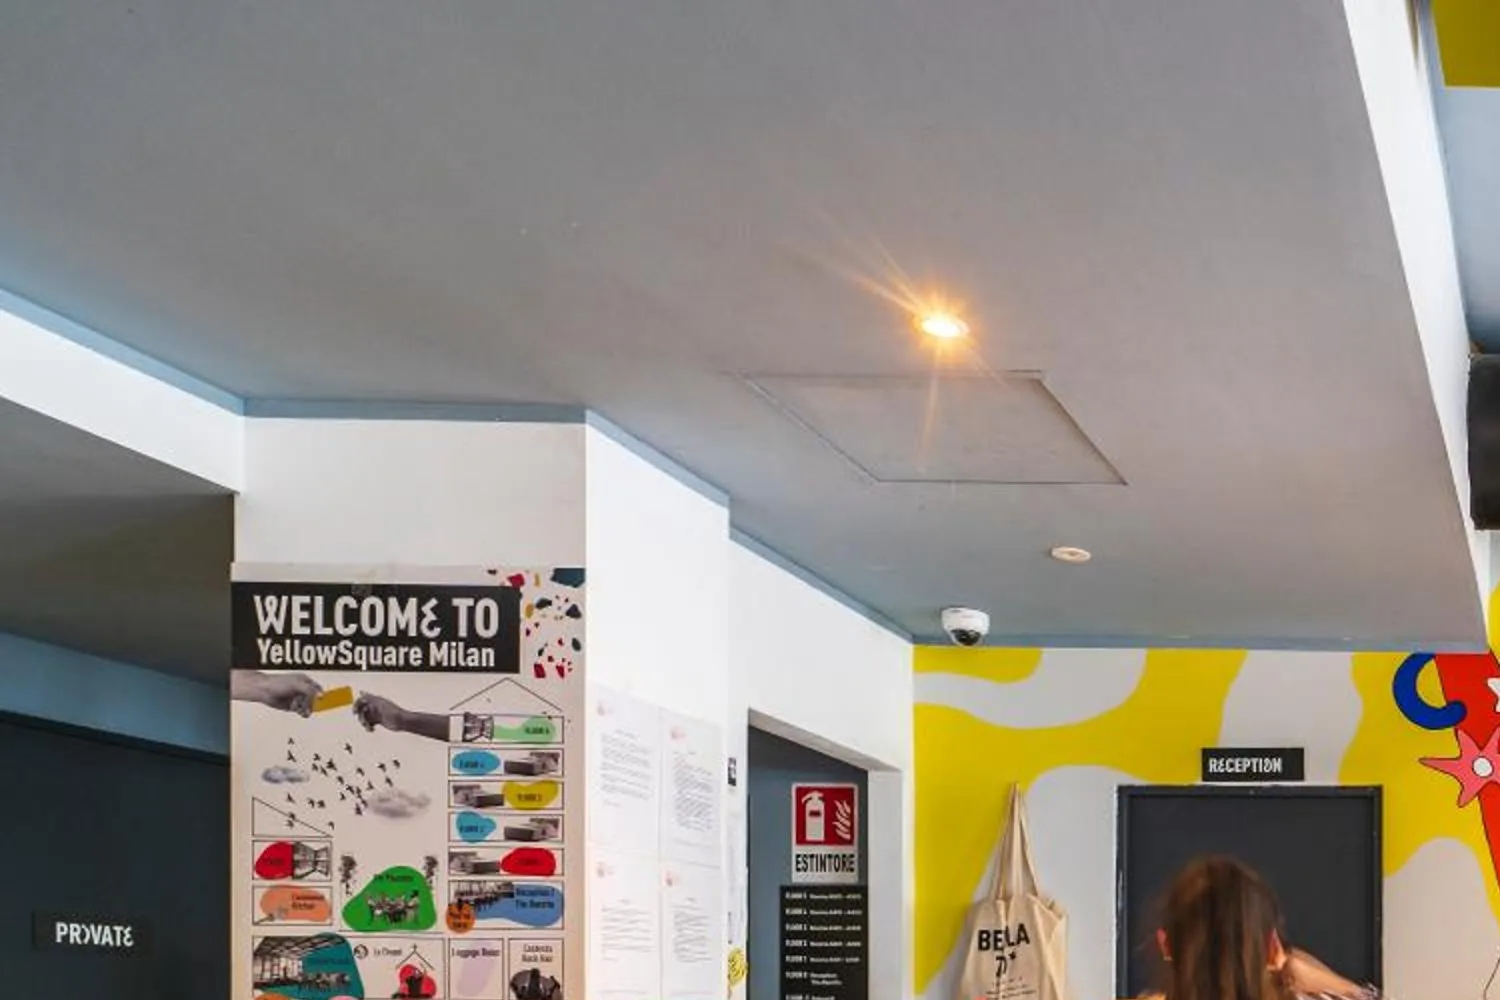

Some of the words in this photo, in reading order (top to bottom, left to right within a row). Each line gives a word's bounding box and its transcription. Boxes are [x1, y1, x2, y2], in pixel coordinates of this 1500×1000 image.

[253, 595, 440, 638] WELCOME
[452, 598, 499, 639] TO
[257, 638, 423, 670] YellowSquare
[429, 641, 495, 667] Milan
[1208, 757, 1282, 773] RECEPTION
[795, 853, 855, 873] ESTINTORE
